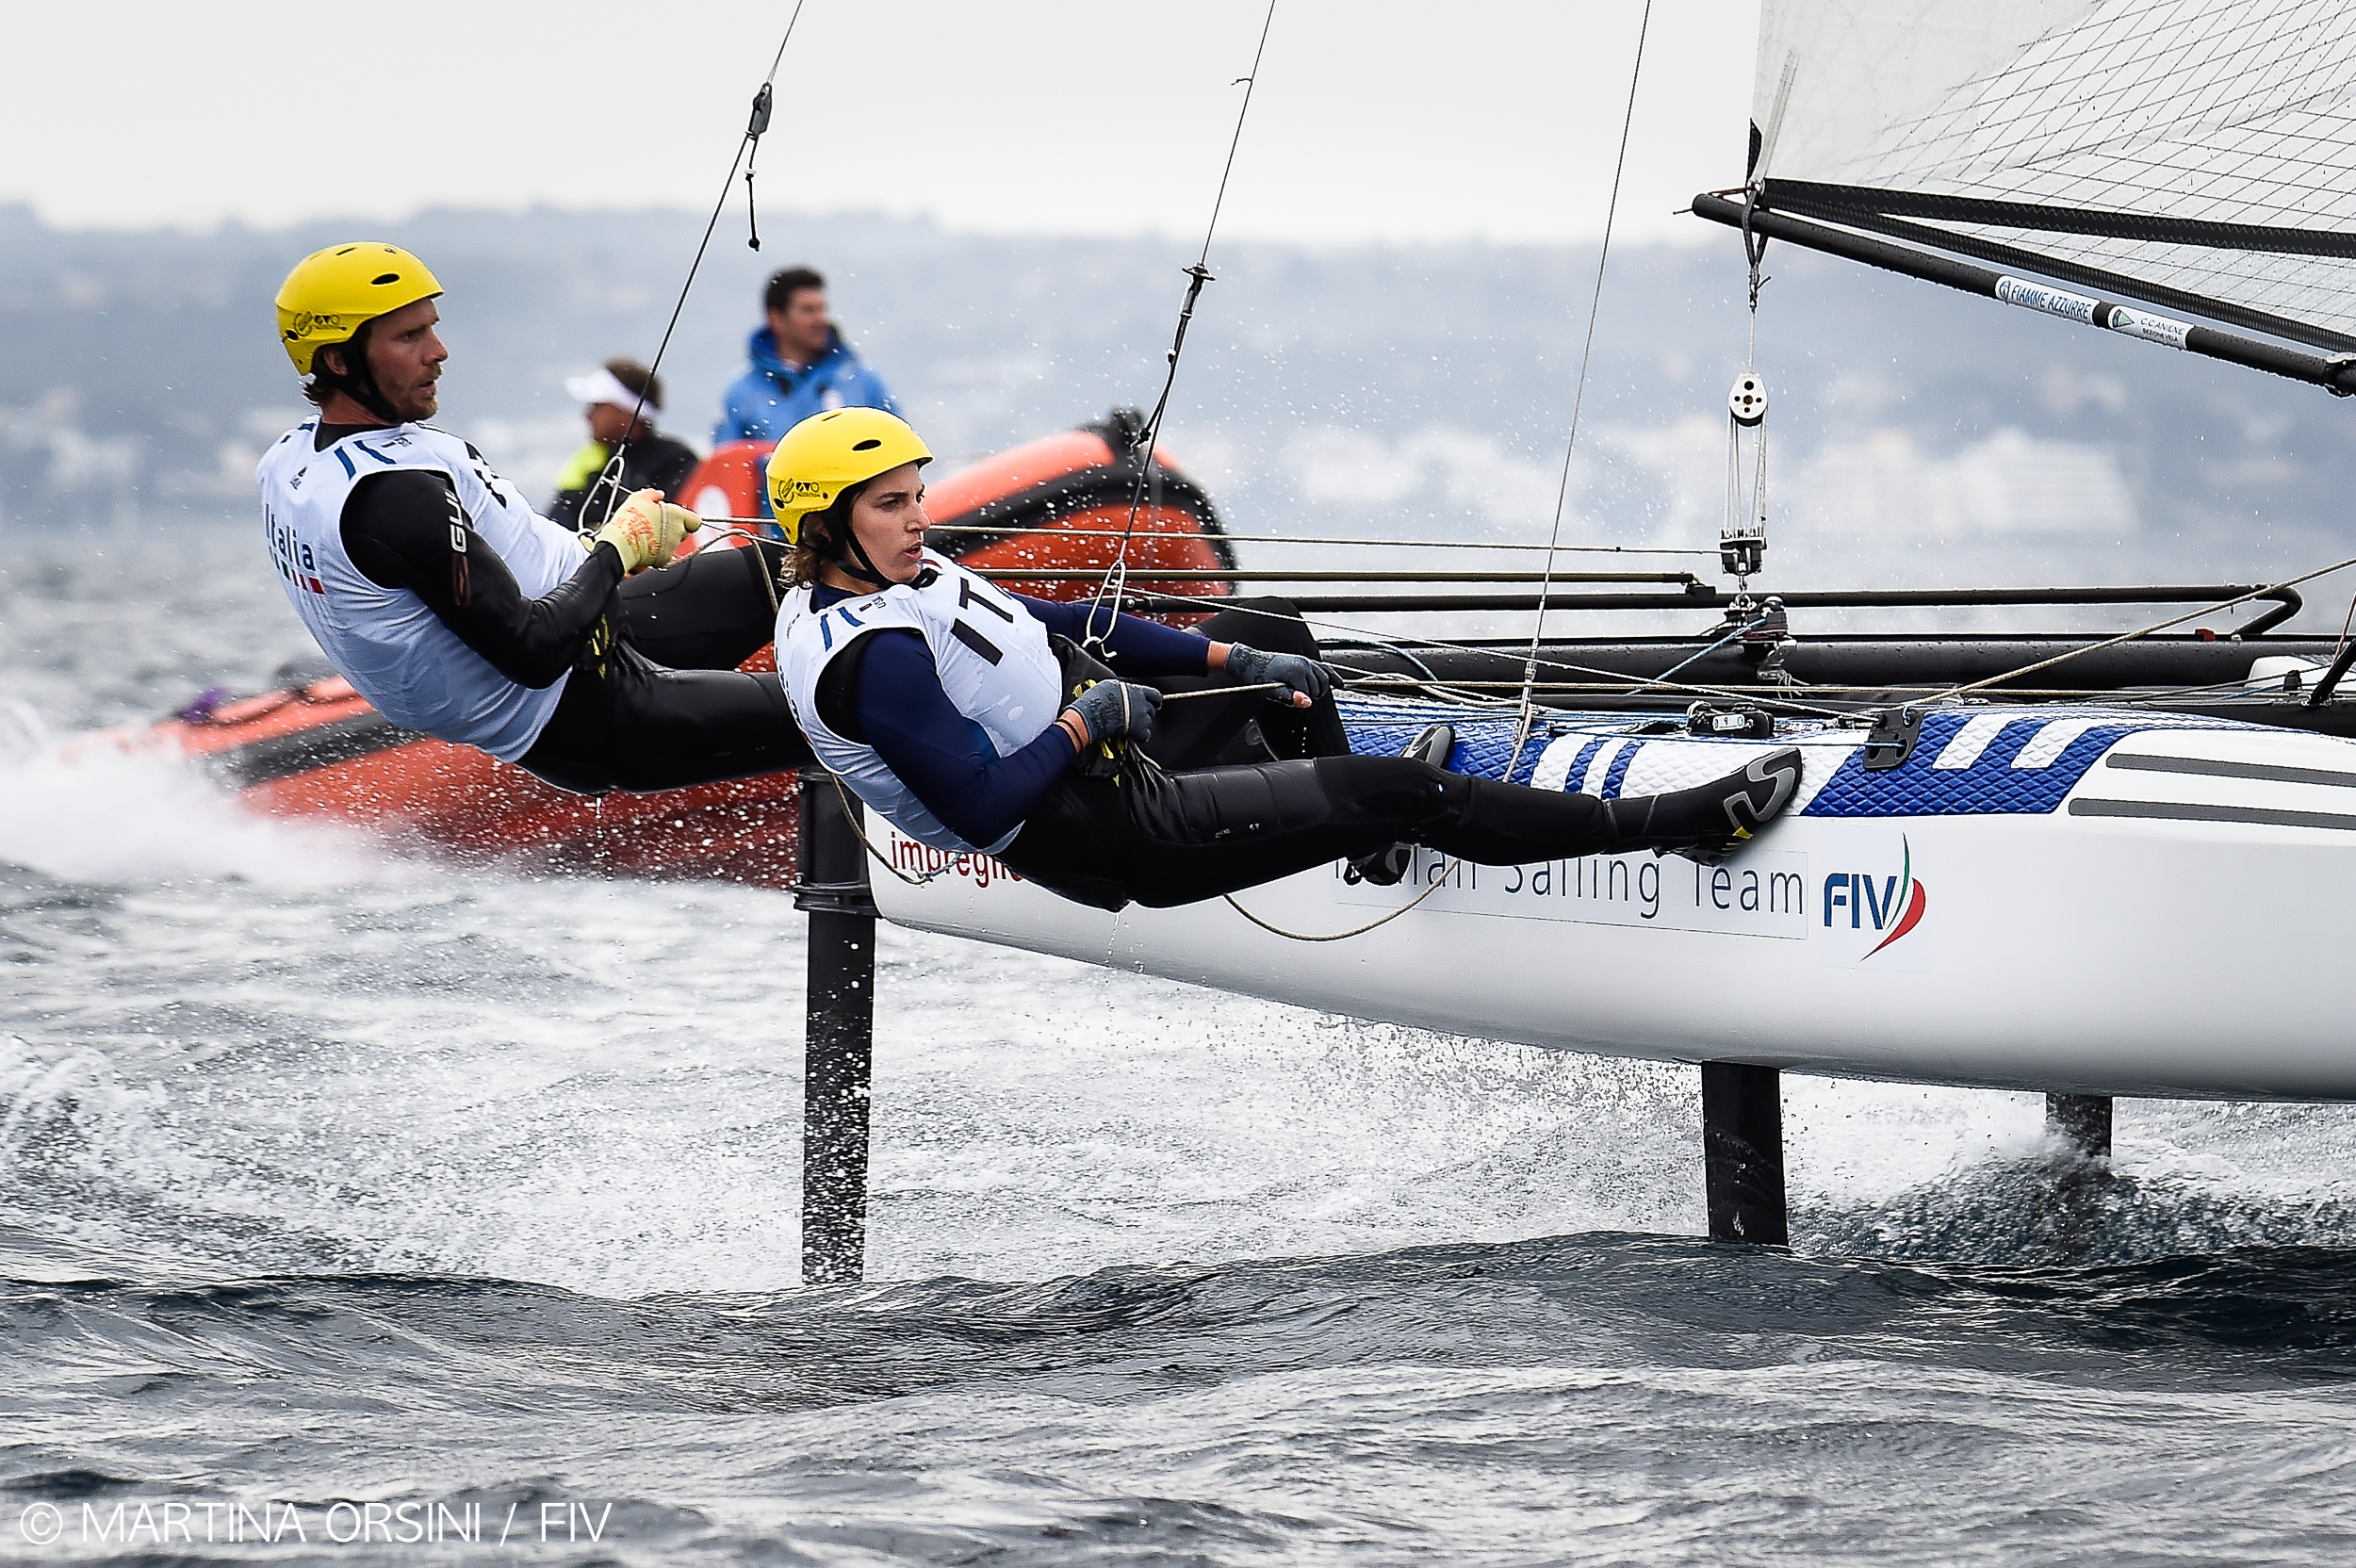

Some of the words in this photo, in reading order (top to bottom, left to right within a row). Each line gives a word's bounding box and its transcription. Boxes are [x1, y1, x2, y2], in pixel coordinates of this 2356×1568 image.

[2011, 285, 2049, 309] FIAMME
[2047, 295, 2092, 319] AZZURRE
[266, 503, 317, 572] Italia
[950, 576, 1014, 668] IT
[1824, 873, 1898, 930] FIV
